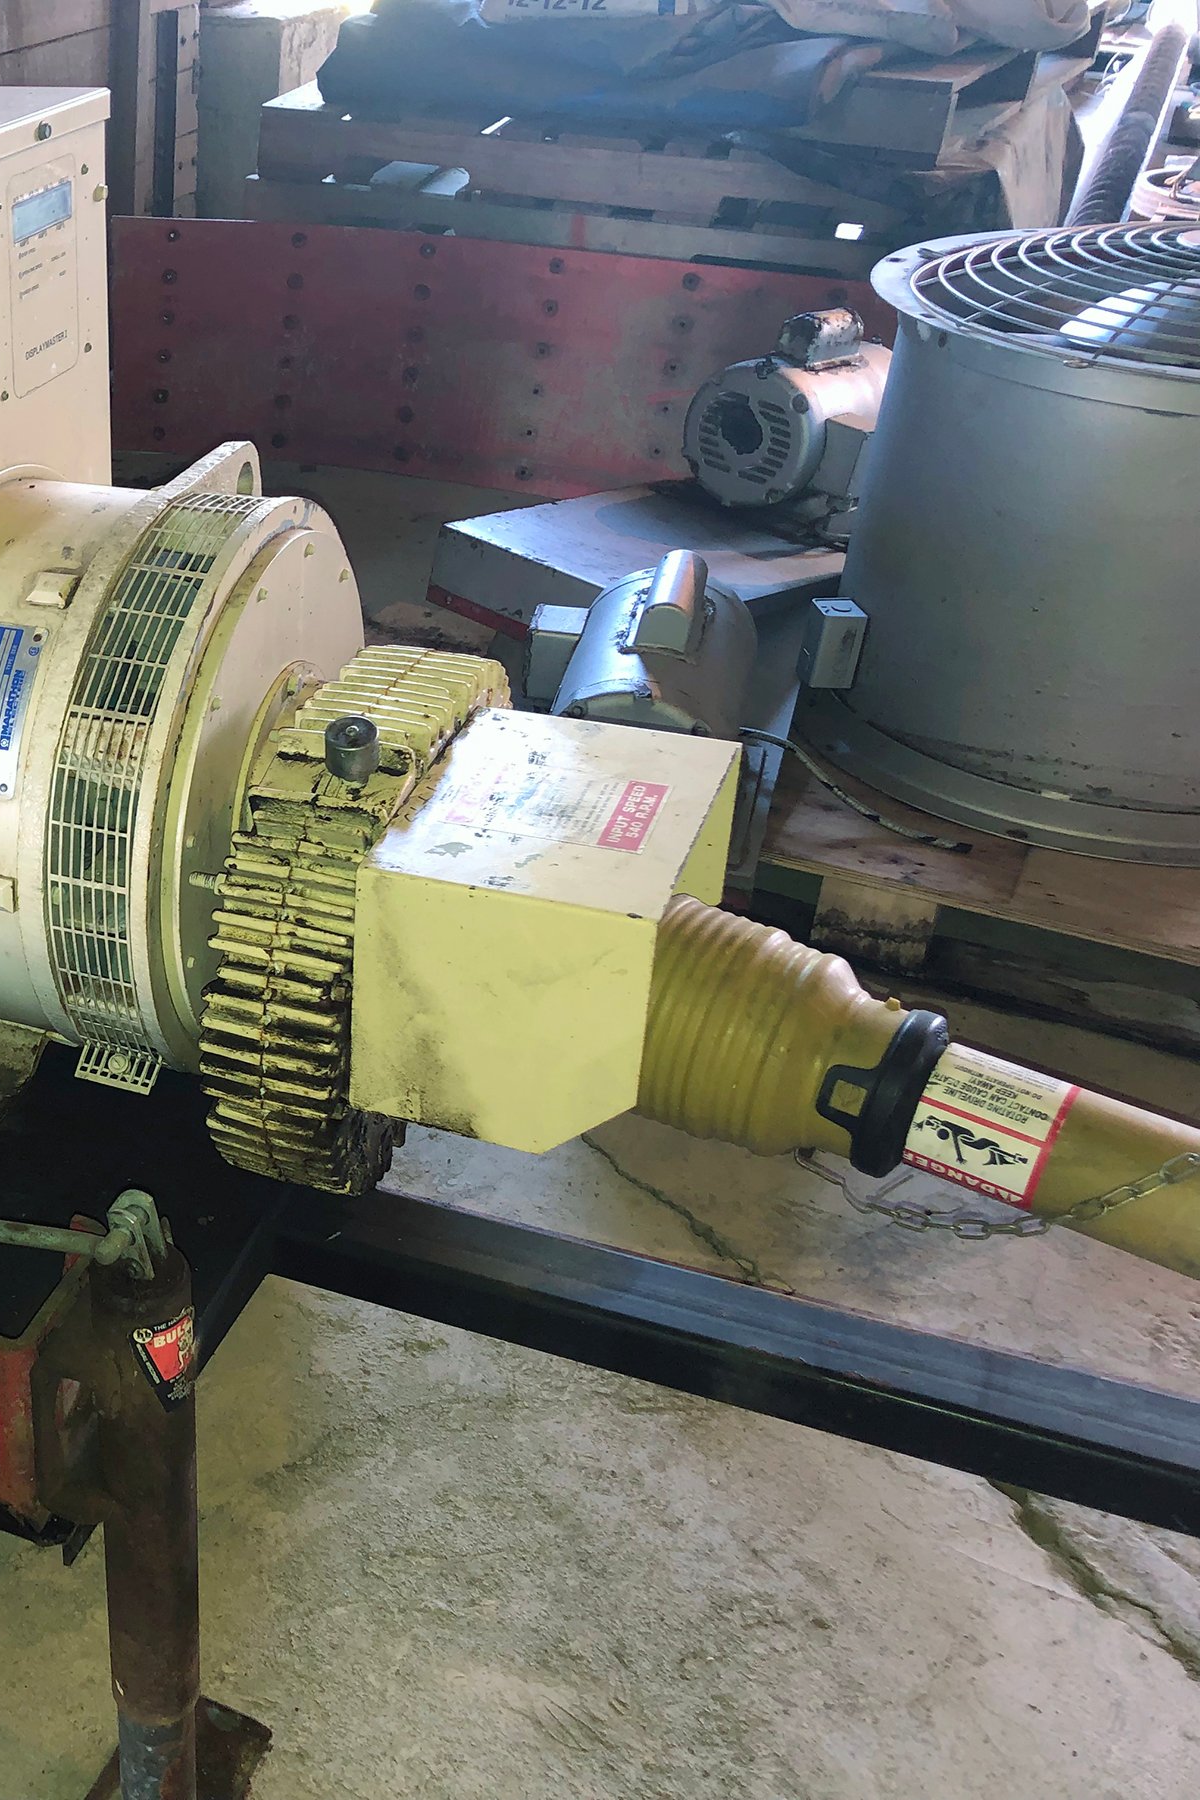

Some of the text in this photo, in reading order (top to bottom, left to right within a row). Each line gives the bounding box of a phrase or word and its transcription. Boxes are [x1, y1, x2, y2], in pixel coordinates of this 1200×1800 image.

[1, 669, 22, 735] MARATHON
[607, 785, 647, 843] INPUT SPEED
[626, 822, 644, 838] 540
[933, 1072, 1048, 1120] CONTACT CAN CAUSE DEATH
[970, 1077, 1018, 1099] KEEP AWAY!
[985, 1076, 1015, 1089] OPERATE
[943, 1086, 1029, 1124] ROTATING DRIVELINE
[902, 1151, 996, 1194] DANGER
[153, 1323, 166, 1331] THE
